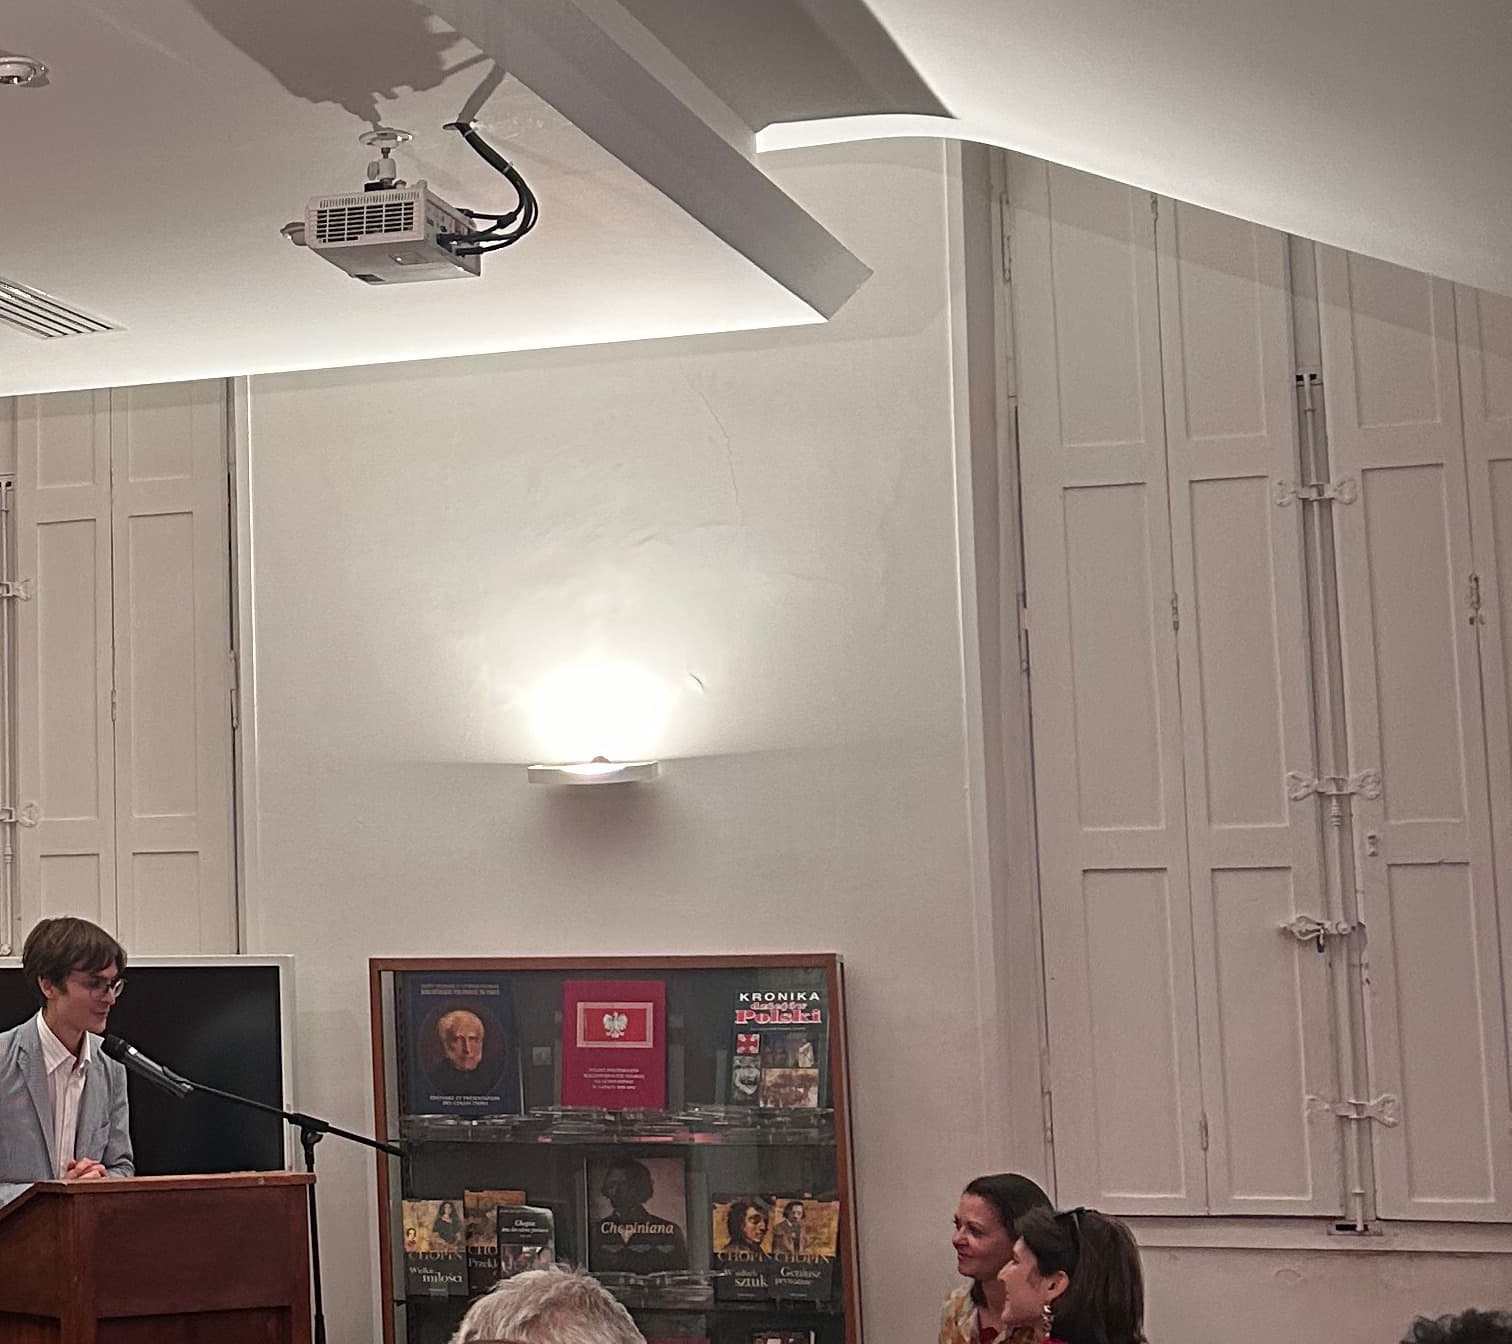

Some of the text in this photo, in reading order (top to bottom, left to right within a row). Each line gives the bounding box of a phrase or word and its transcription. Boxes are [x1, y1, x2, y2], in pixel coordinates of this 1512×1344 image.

[738, 991, 821, 1002] KRONIKA
[734, 1008, 823, 1024] Polski
[600, 1221, 675, 1236] Chopiniana
